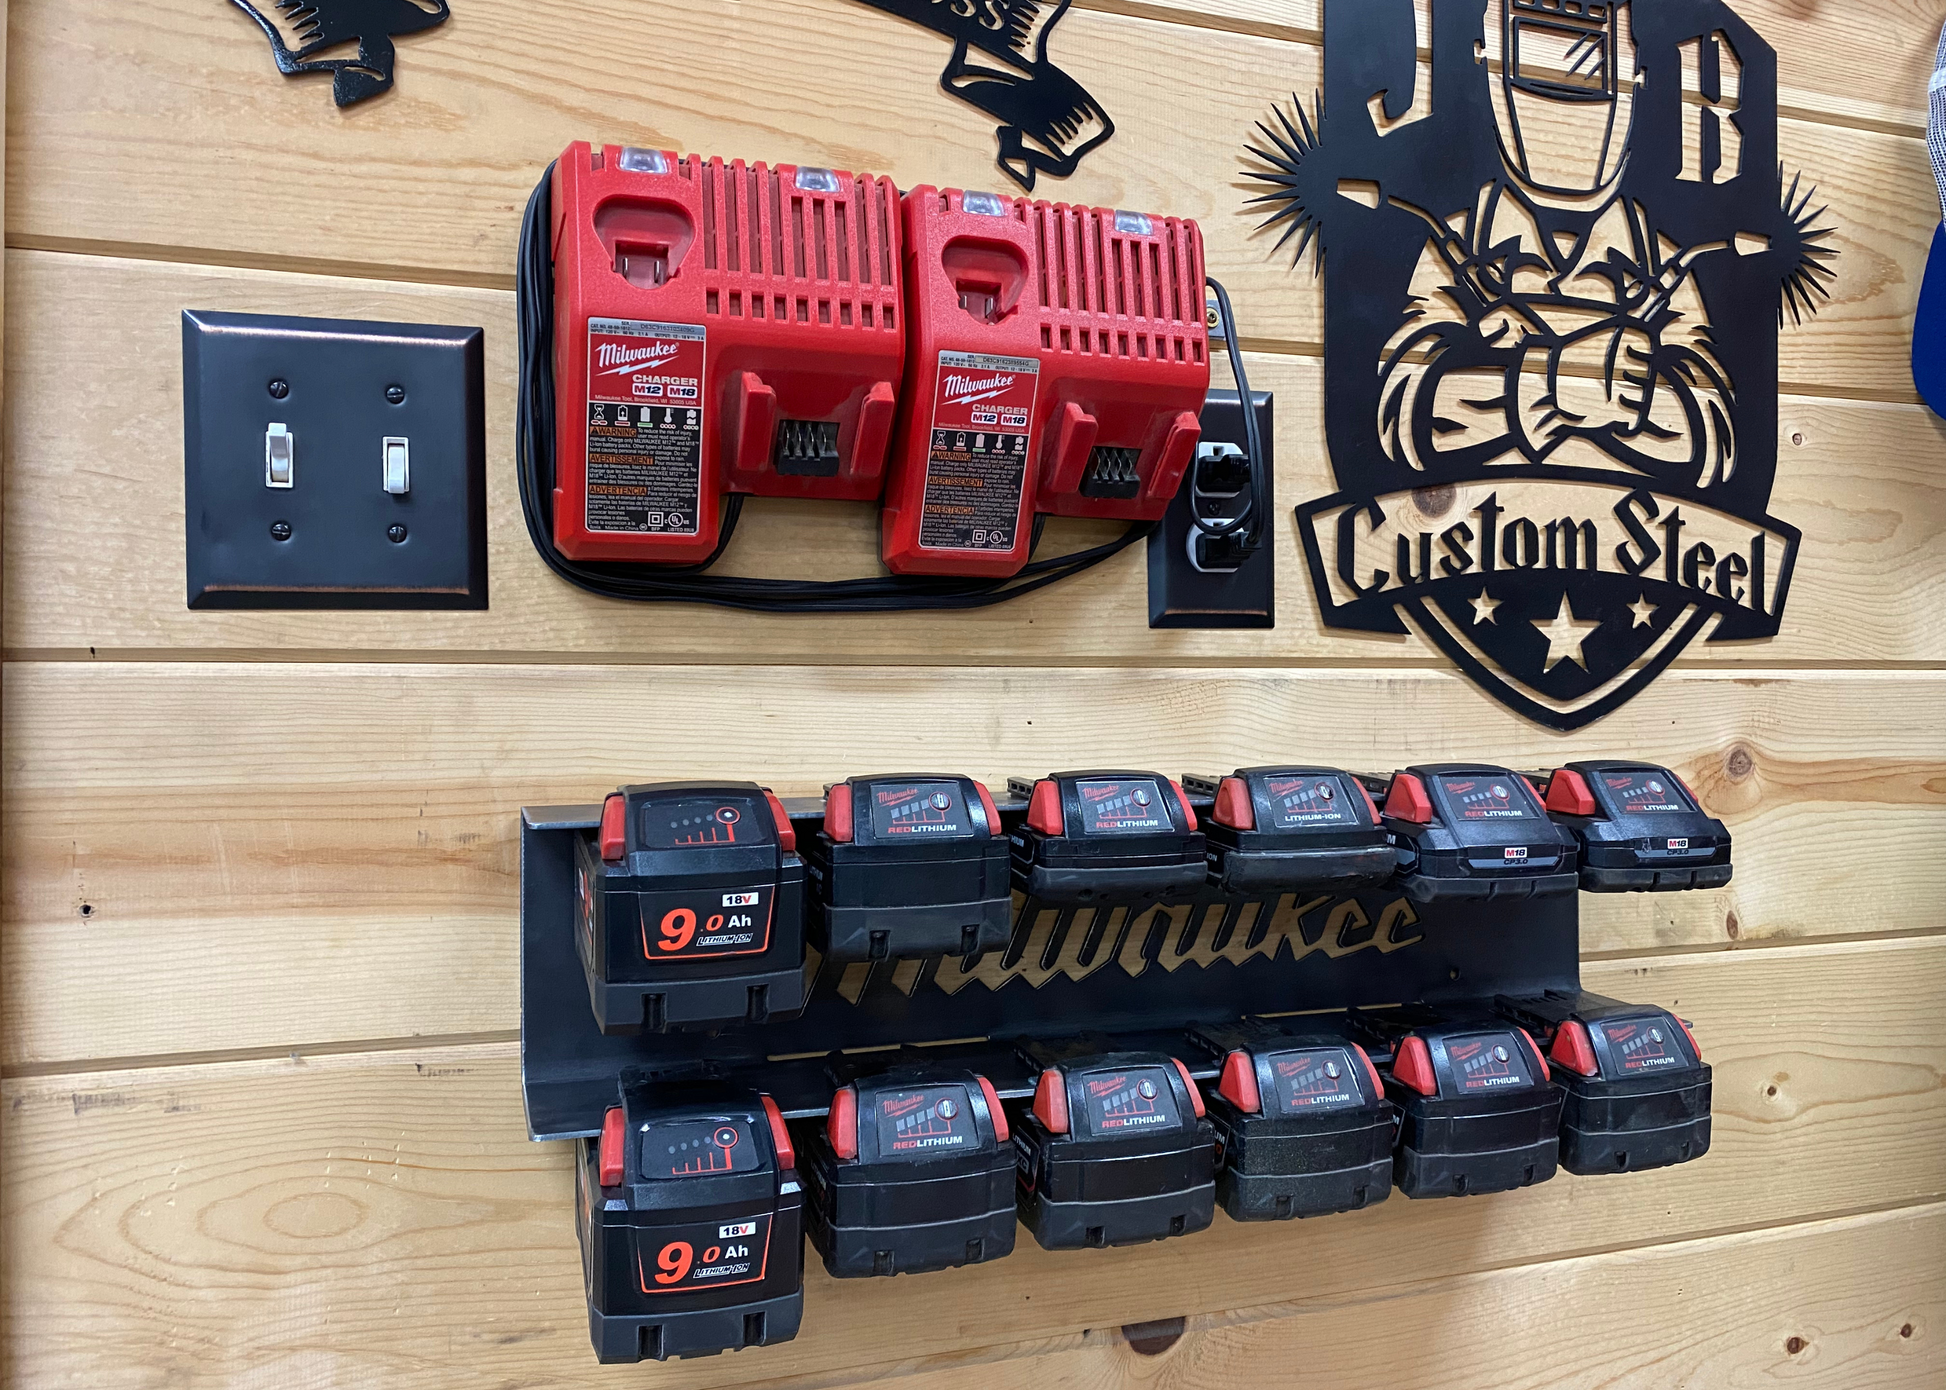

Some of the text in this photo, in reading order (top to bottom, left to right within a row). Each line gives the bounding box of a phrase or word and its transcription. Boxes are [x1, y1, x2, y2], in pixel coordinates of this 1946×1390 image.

[632, 374, 698, 386] CHARGER
[634, 385, 696, 397] M12 M18
[972, 404, 1028, 415] CHARGER
[973, 414, 1025, 424] M12 M18
[598, 426, 635, 436] WARNING
[590, 453, 652, 464] AVERTISSEMENT
[938, 451, 971, 461] WARNING
[928, 476, 982, 487] AVERTISSEMENT
[589, 485, 646, 495] ADVERTENCIA
[925, 504, 974, 515] ADVERTENCIA
[1337, 486, 1767, 612] Custom Steel
[1284, 813, 1342, 822] LITHIUM-ION
[888, 824, 956, 834] REDLITHIUM
[1096, 819, 1158, 828] REDLITHIUM
[1669, 840, 1687, 848] M18
[1506, 849, 1526, 857] M18
[726, 894, 752, 905] 18V
[728, 914, 751, 928] Ah
[1625, 1057, 1675, 1069] REDLITHIUM
[1466, 1076, 1520, 1088] REDLITHIUM
[1291, 1093, 1350, 1106] REDLITHIUM
[1102, 1114, 1165, 1128] REDLITHIUM
[893, 1135, 963, 1150] REDLITHIUM
[723, 1224, 749, 1236] 18V
[725, 1245, 749, 1259] Ah
